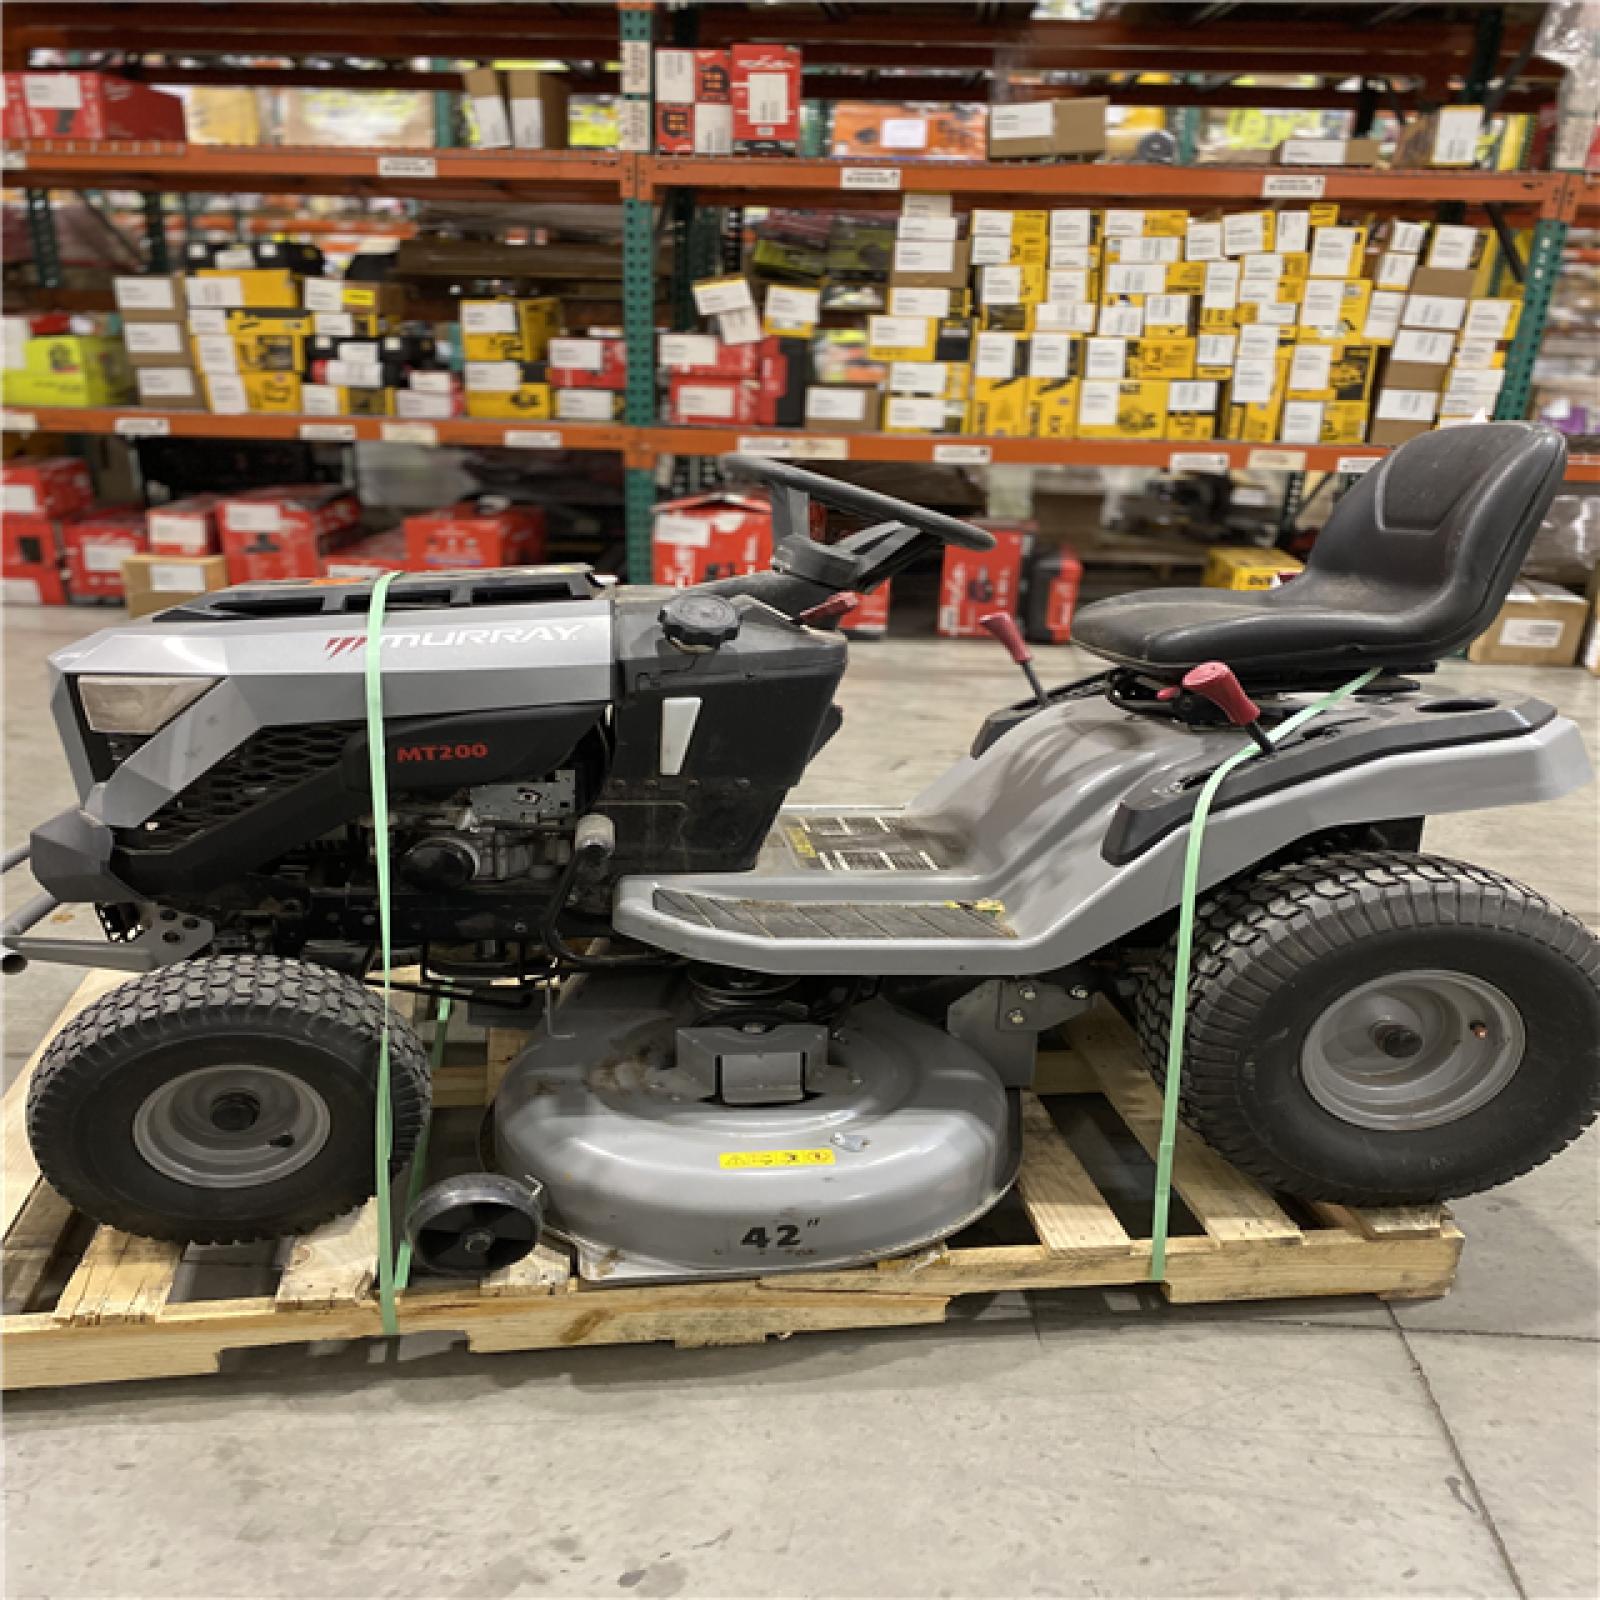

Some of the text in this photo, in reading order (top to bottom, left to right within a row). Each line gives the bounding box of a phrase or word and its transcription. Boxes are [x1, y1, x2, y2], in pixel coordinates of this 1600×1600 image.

[380, 624, 584, 648] MURRAY
[396, 742, 488, 763] MT200
[740, 1217, 820, 1248] 42"
